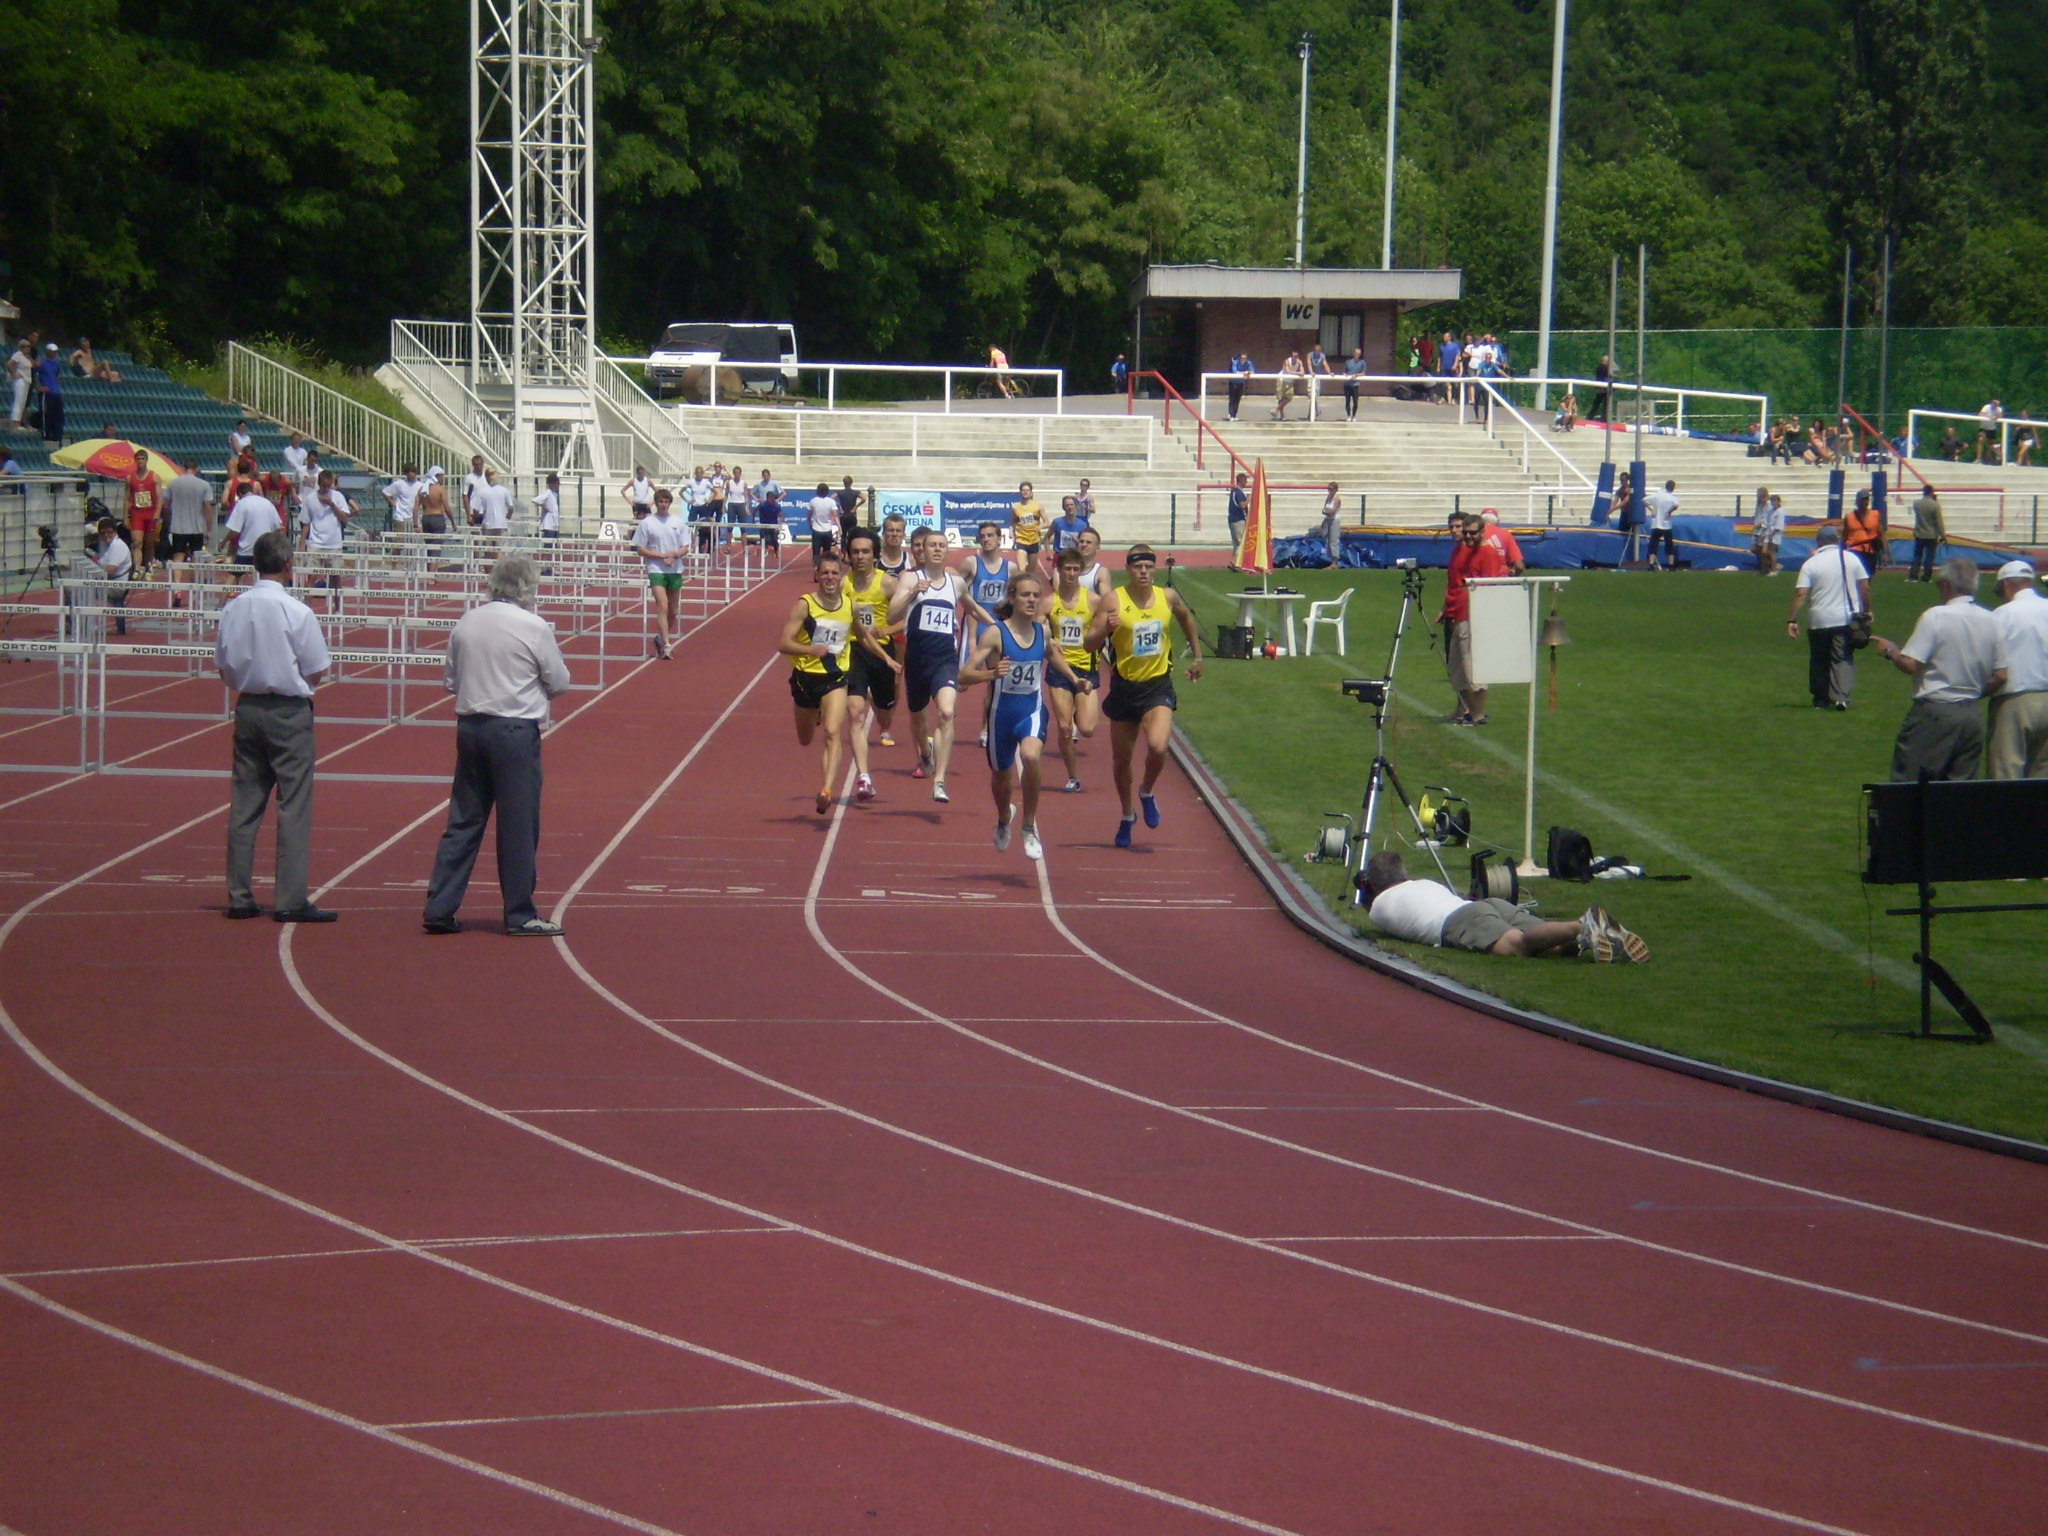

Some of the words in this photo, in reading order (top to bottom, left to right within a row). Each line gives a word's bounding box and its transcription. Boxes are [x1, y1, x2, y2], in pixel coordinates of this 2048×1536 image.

[1287, 304, 1313, 319] WC
[883, 502, 922, 516] ČESKÁ
[604, 524, 614, 537] 8
[948, 533, 956, 544] 2
[1000, 533, 1006, 545] 1
[312, 568, 390, 576] NORDICSPORT.COM
[82, 581, 172, 589] NORDICSPORT.COM
[554, 577, 629, 585] NORDICSPORT.COM
[362, 591, 449, 599] NORDICSPORT.COM
[982, 581, 1001, 598] 101
[102, 608, 205, 619] NORDICSPORT.COM
[925, 610, 949, 628] 144
[824, 629, 838, 643] 14
[1061, 626, 1081, 638] 170
[1136, 632, 1159, 647] 158
[0, 643, 57, 652] ORT.COM
[328, 654, 442, 665] ORDICSPORT.COM
[1011, 664, 1035, 686] 94
